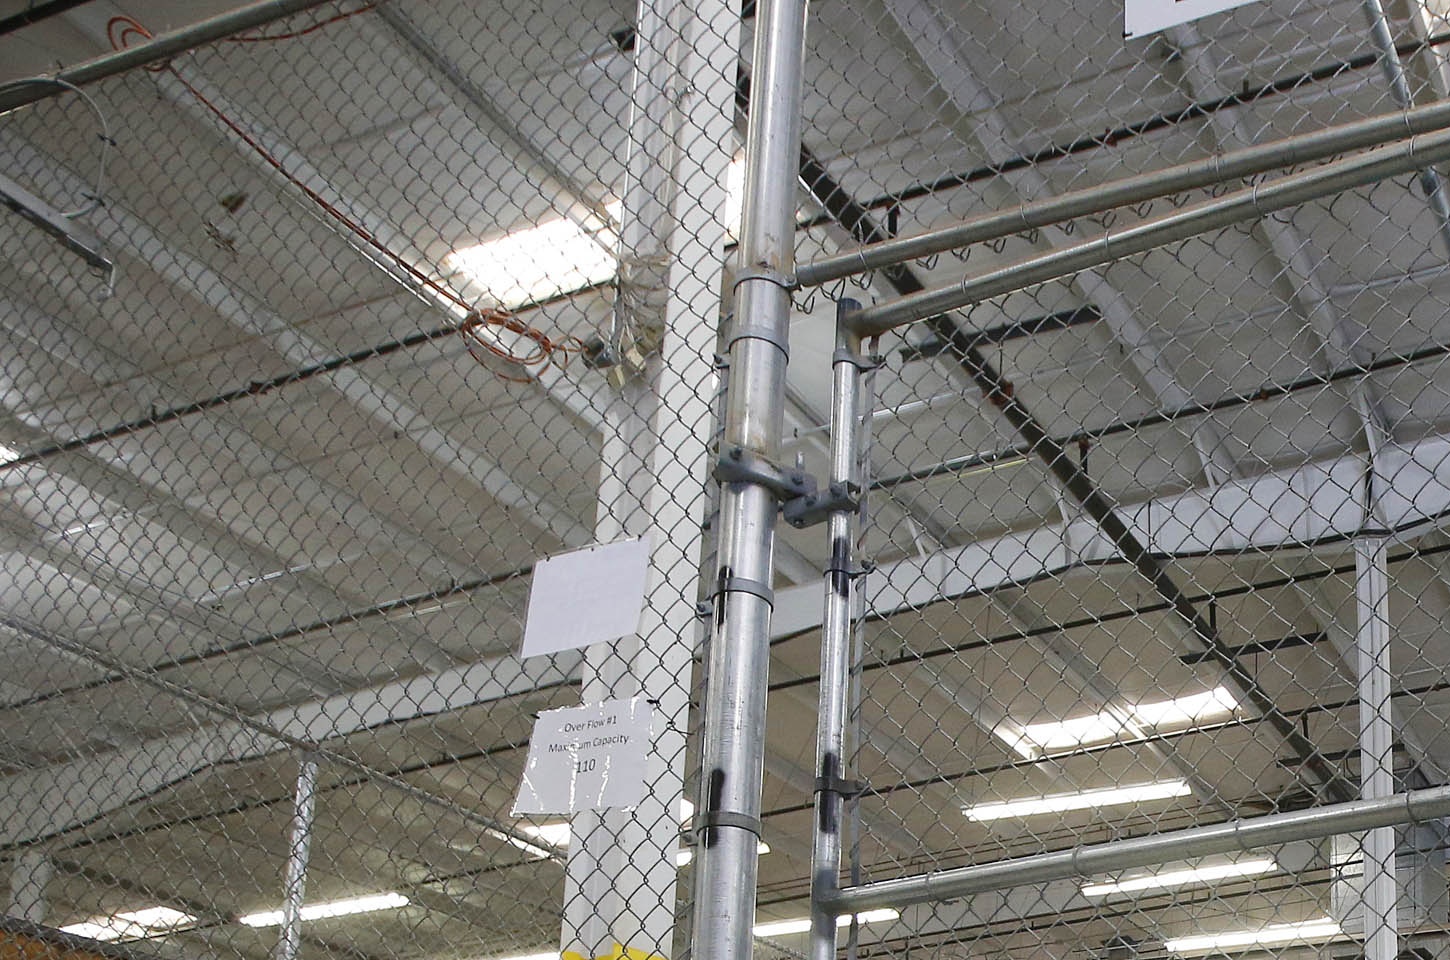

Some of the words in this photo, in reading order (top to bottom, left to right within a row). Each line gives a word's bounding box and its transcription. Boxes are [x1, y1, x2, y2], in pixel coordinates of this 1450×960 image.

[564, 721, 586, 733] Over
[586, 718, 606, 730] Flow
[606, 715, 617, 725] #1
[592, 734, 630, 748] Capacity
[576, 758, 596, 774] 110
